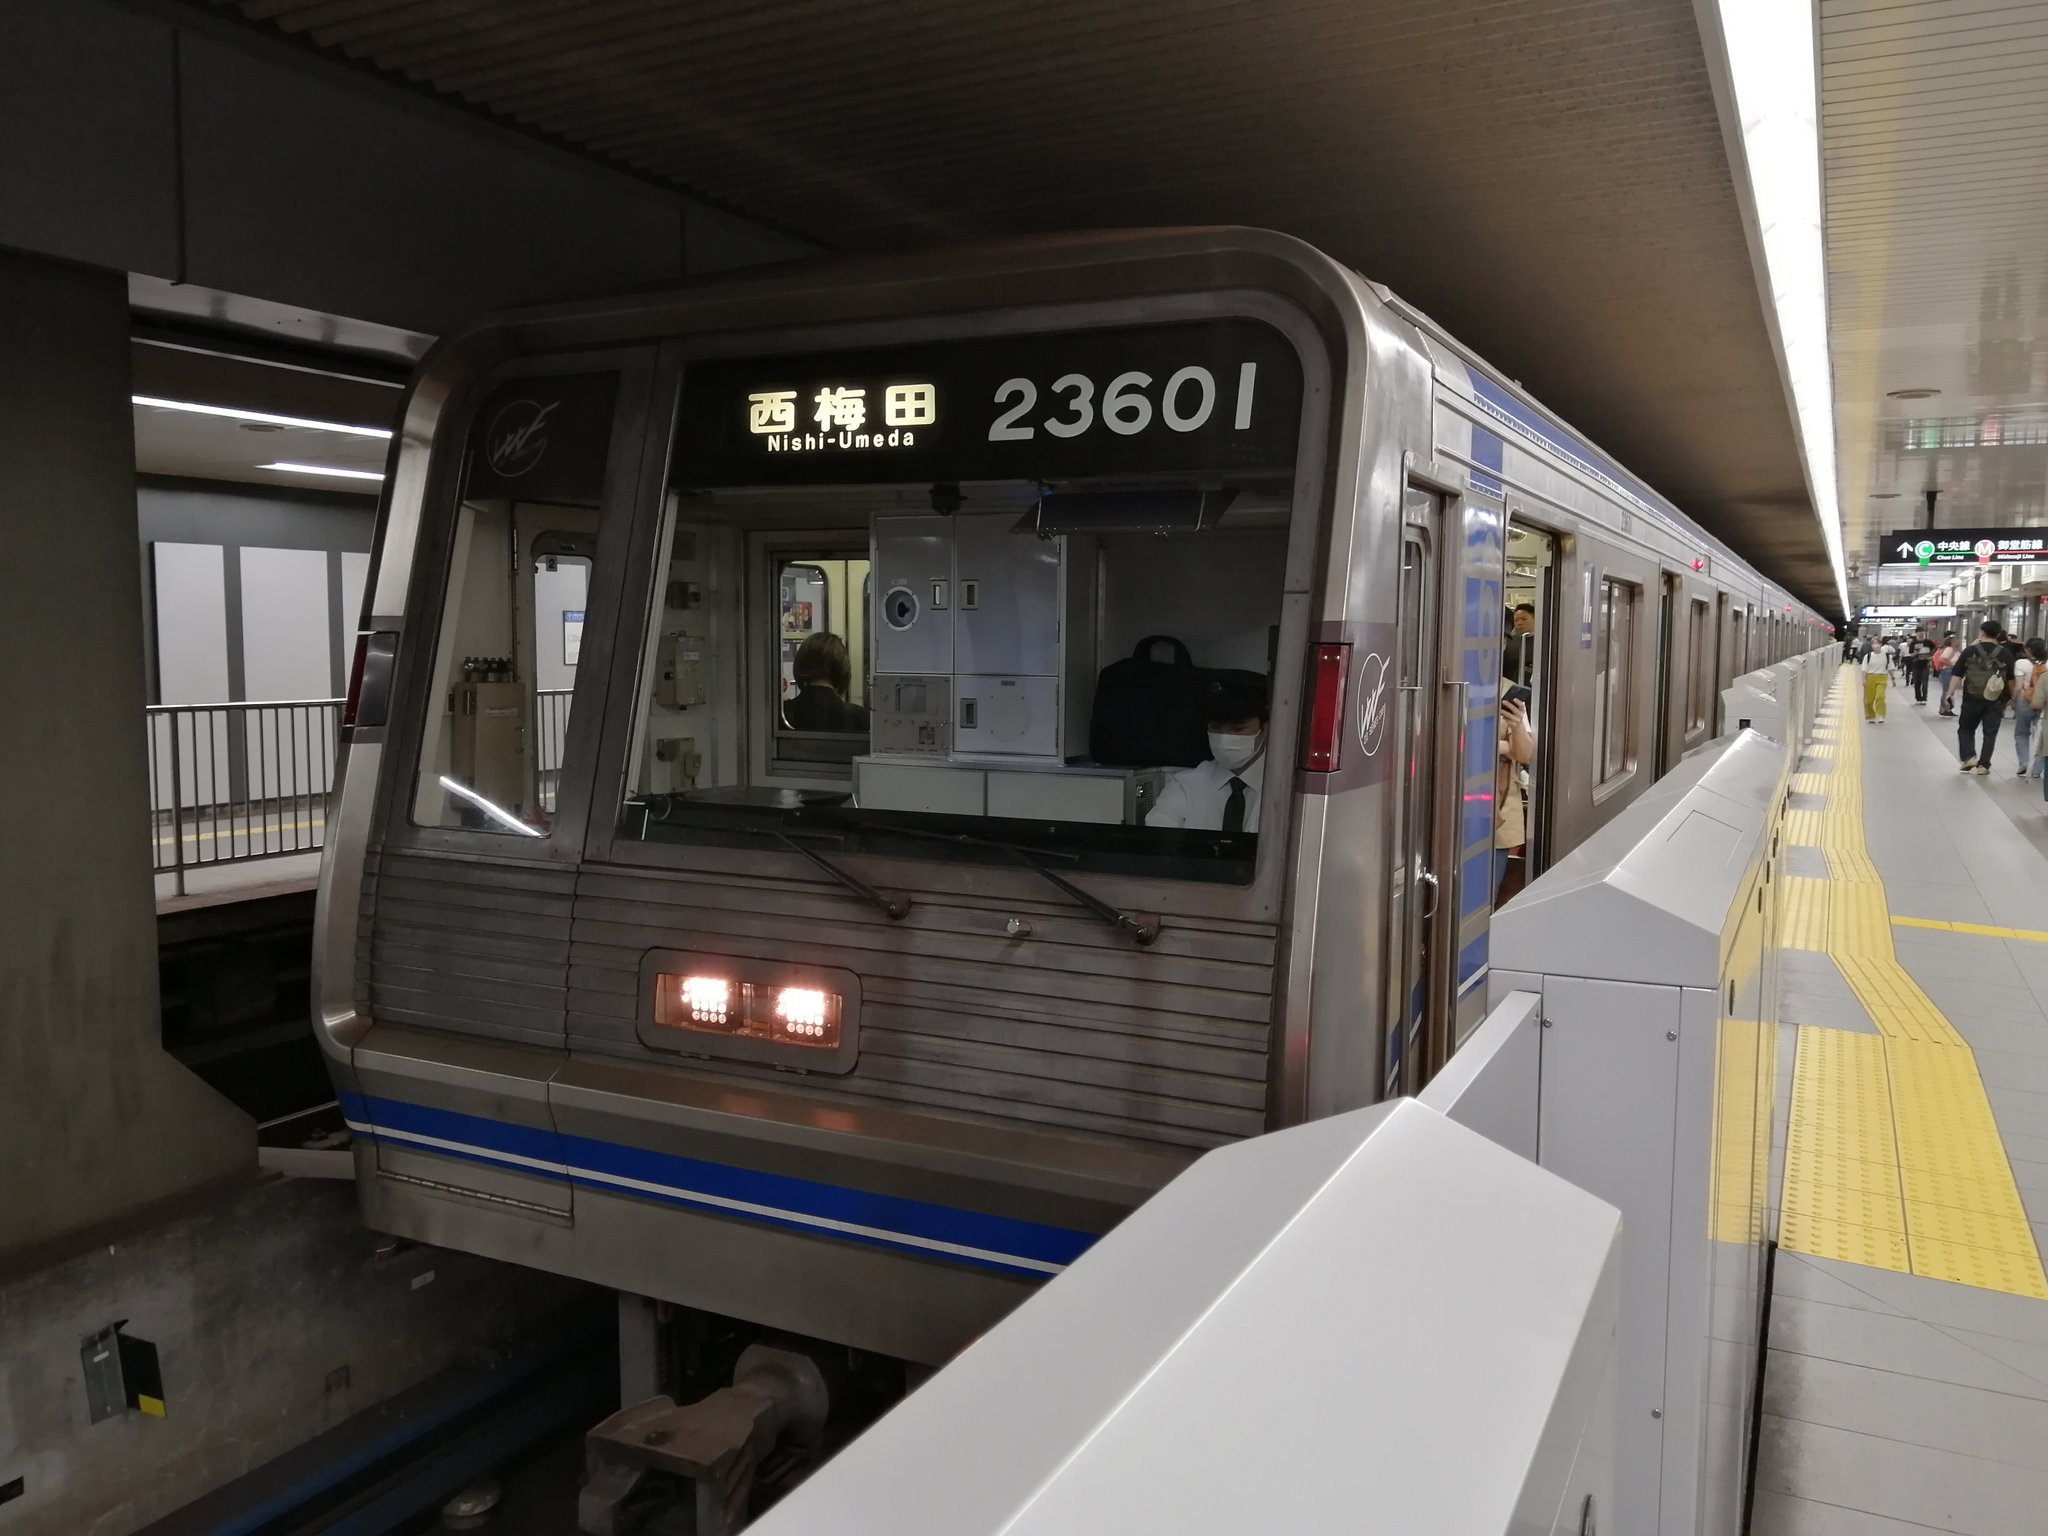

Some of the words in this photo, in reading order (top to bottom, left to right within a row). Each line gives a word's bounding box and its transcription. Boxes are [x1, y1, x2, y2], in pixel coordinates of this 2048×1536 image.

[748, 383, 936, 434] 西梅田
[988, 362, 1257, 441] 23601
[767, 428, 914, 452] Nishi-Umeda
